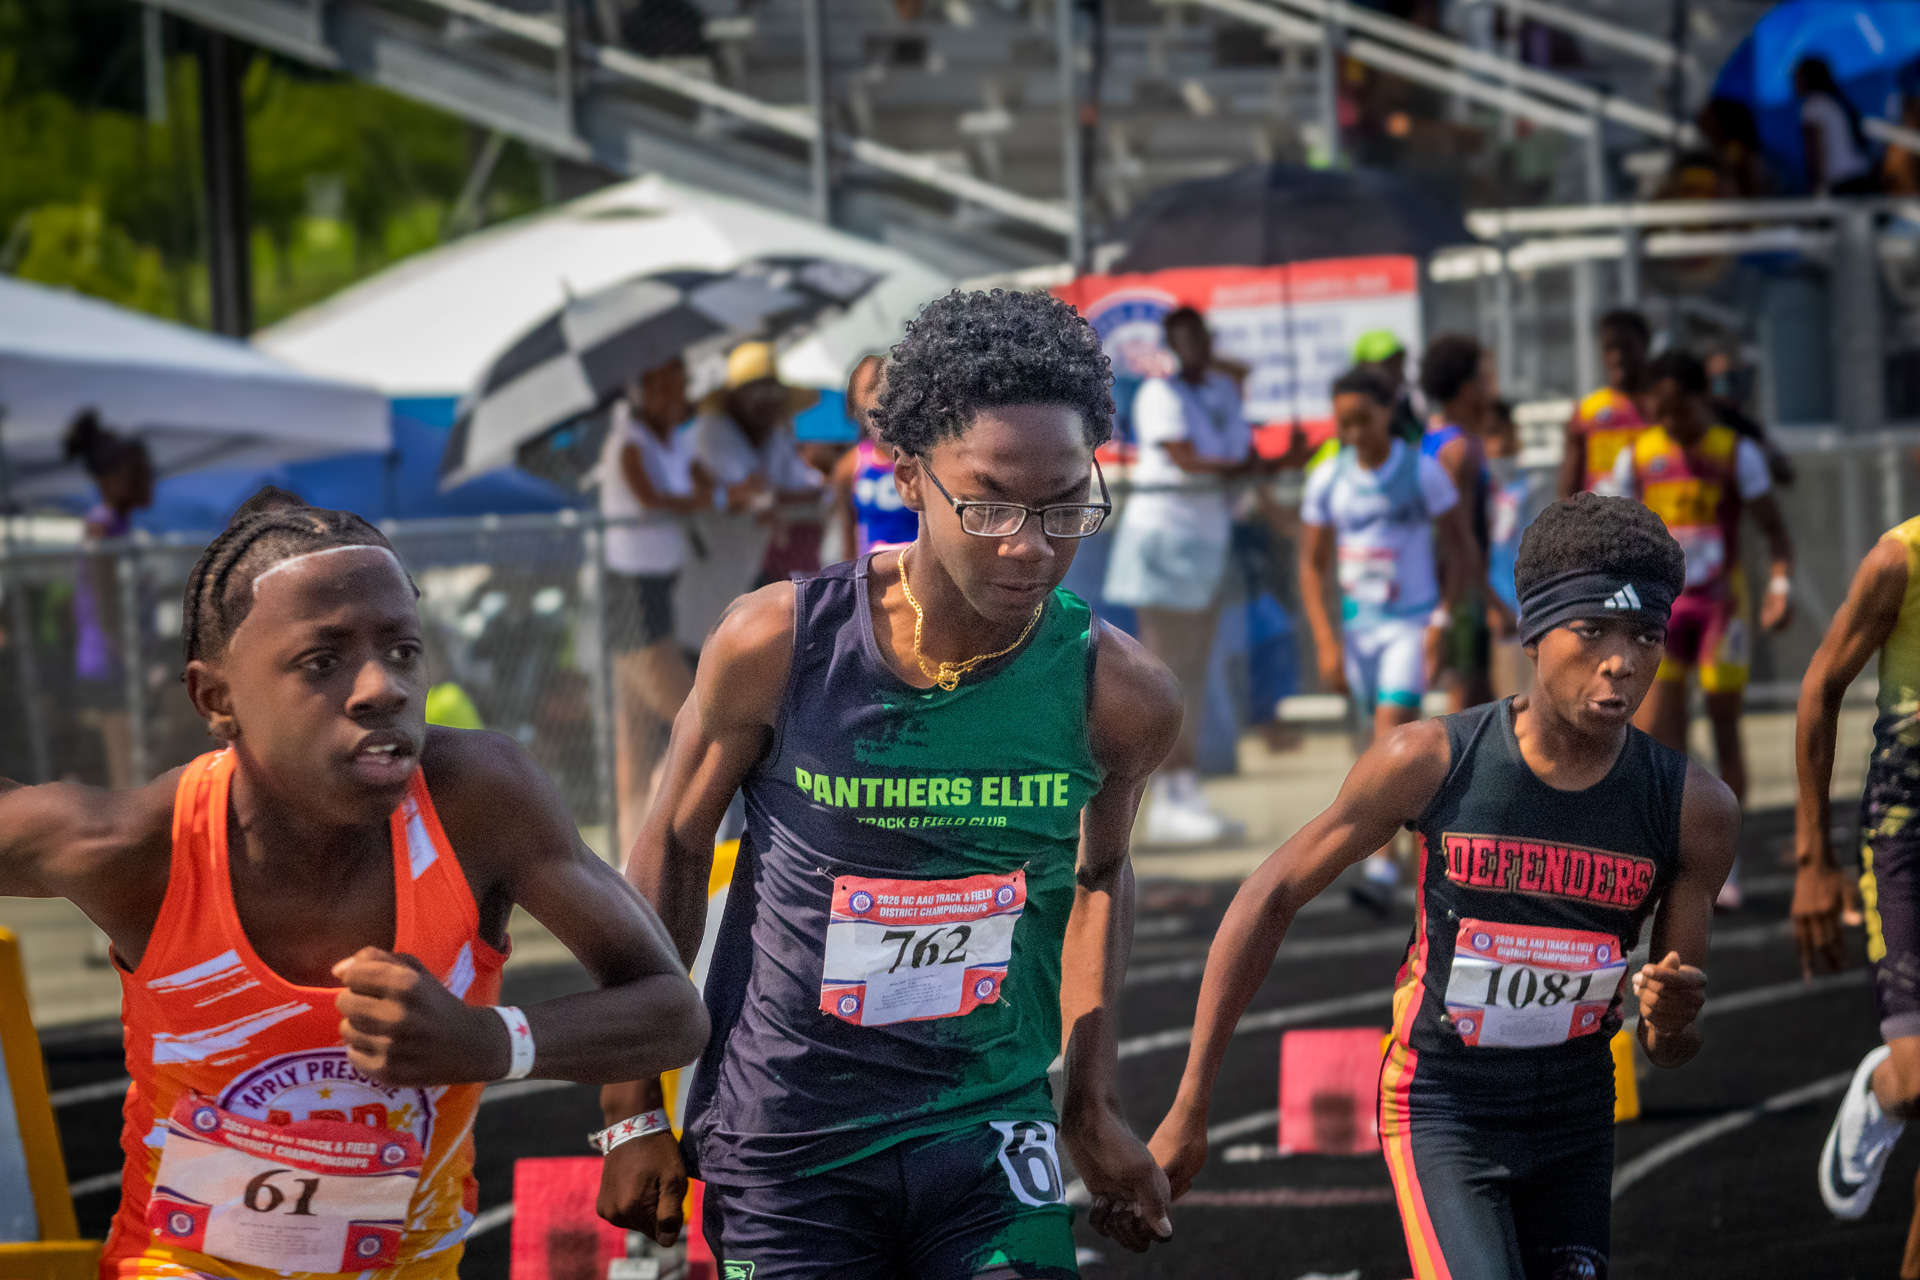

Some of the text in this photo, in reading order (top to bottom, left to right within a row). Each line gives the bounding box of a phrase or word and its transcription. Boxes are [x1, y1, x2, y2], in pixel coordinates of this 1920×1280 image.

[795, 766, 1069, 808] PANTHERS ELITE
[909, 816, 919, 828] &
[922, 816, 966, 827] FIELD
[968, 816, 1007, 828] CLUB
[1446, 837, 1652, 906] DEFENDERS
[877, 894, 900, 905] 2026
[901, 895, 915, 906] NC
[916, 895, 935, 905] AAU
[936, 893, 962, 904] TRACK
[963, 892, 970, 902] &
[970, 889, 993, 902] FIELD
[880, 902, 988, 918] DISTRICT CHAMPIONSHIPS
[880, 925, 972, 974] 762
[1497, 946, 1590, 965] DISTRICT CHAMPIONSHIPS
[1546, 939, 1570, 951] TRACK
[1577, 942, 1594, 953] FIELD
[1484, 966, 1593, 1010] 1081
[242, 1066, 299, 1110] APPLY
[345, 1142, 378, 1155] FIELD
[1005, 1121, 1061, 1202] 6
[244, 1168, 320, 1216] 61
